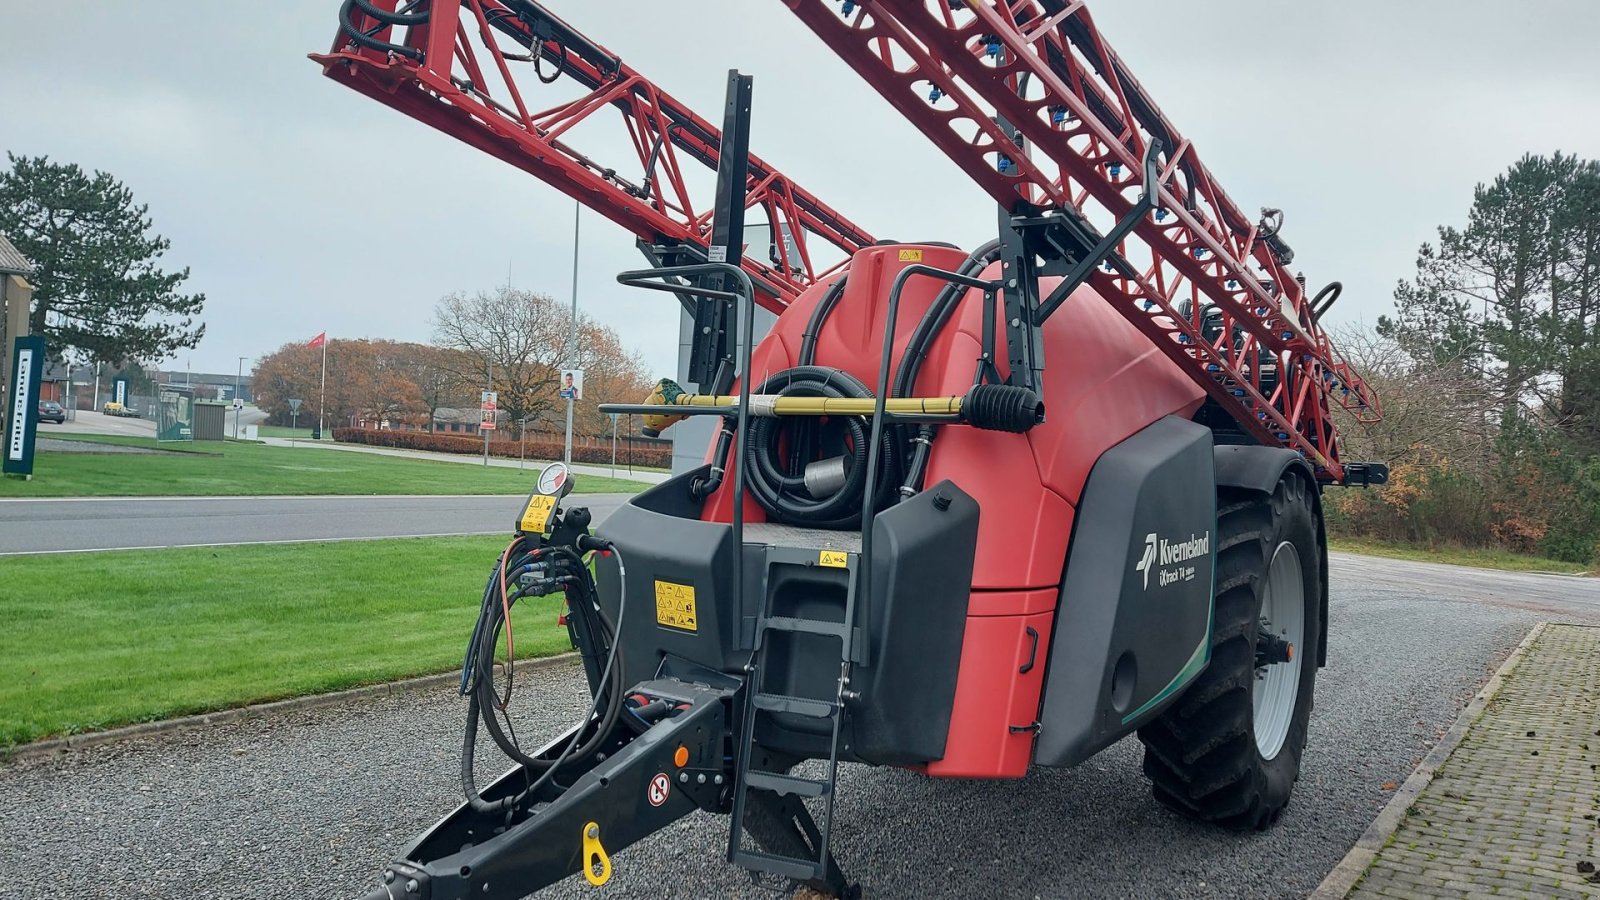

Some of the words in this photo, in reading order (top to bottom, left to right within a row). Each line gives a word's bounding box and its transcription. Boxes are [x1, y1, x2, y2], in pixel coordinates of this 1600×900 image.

[19, 358, 28, 396] Land
[14, 412, 22, 451] Fritid
[1160, 531, 1209, 566] Kverneland
[1160, 568, 1178, 587] iXtrack
[1178, 566, 1185, 580] T4
